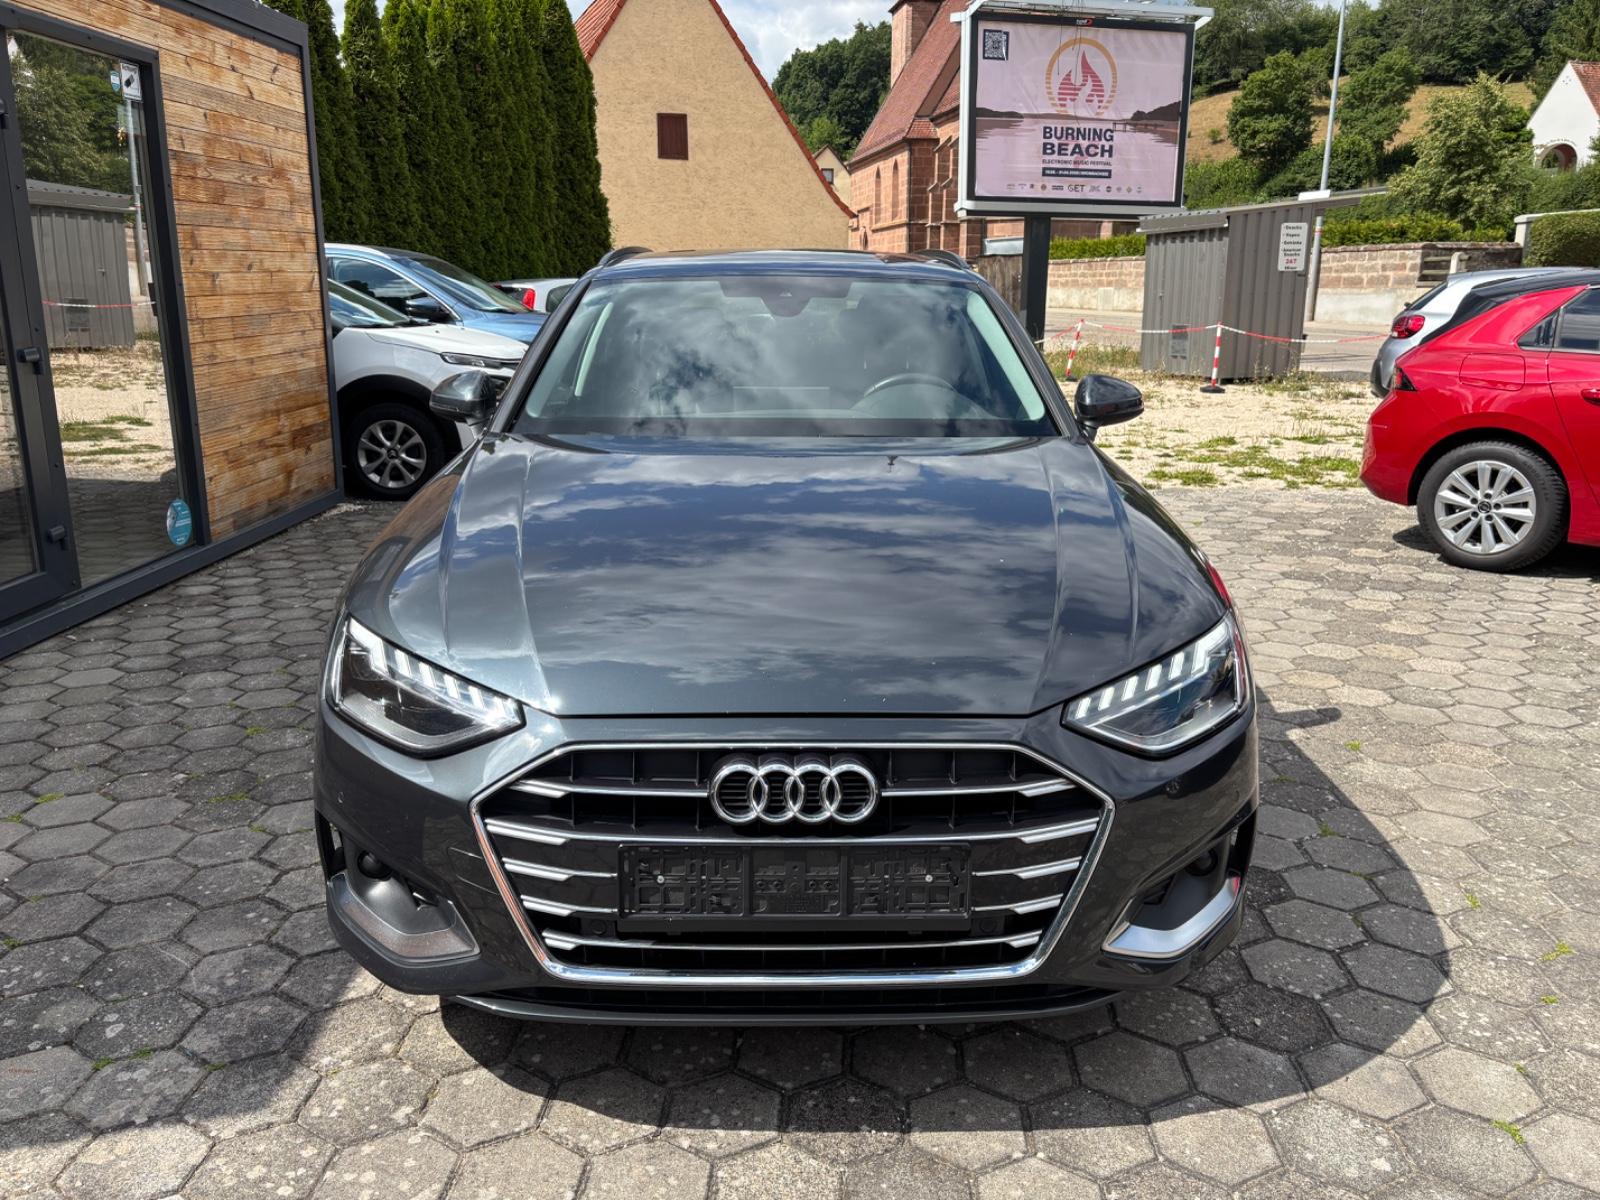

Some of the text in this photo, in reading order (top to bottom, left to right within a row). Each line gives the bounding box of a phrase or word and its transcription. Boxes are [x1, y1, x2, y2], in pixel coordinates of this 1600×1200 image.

[1043, 126, 1114, 142] BURNING
[1043, 142, 1113, 157] BEACH
[1067, 184, 1085, 193] GET
